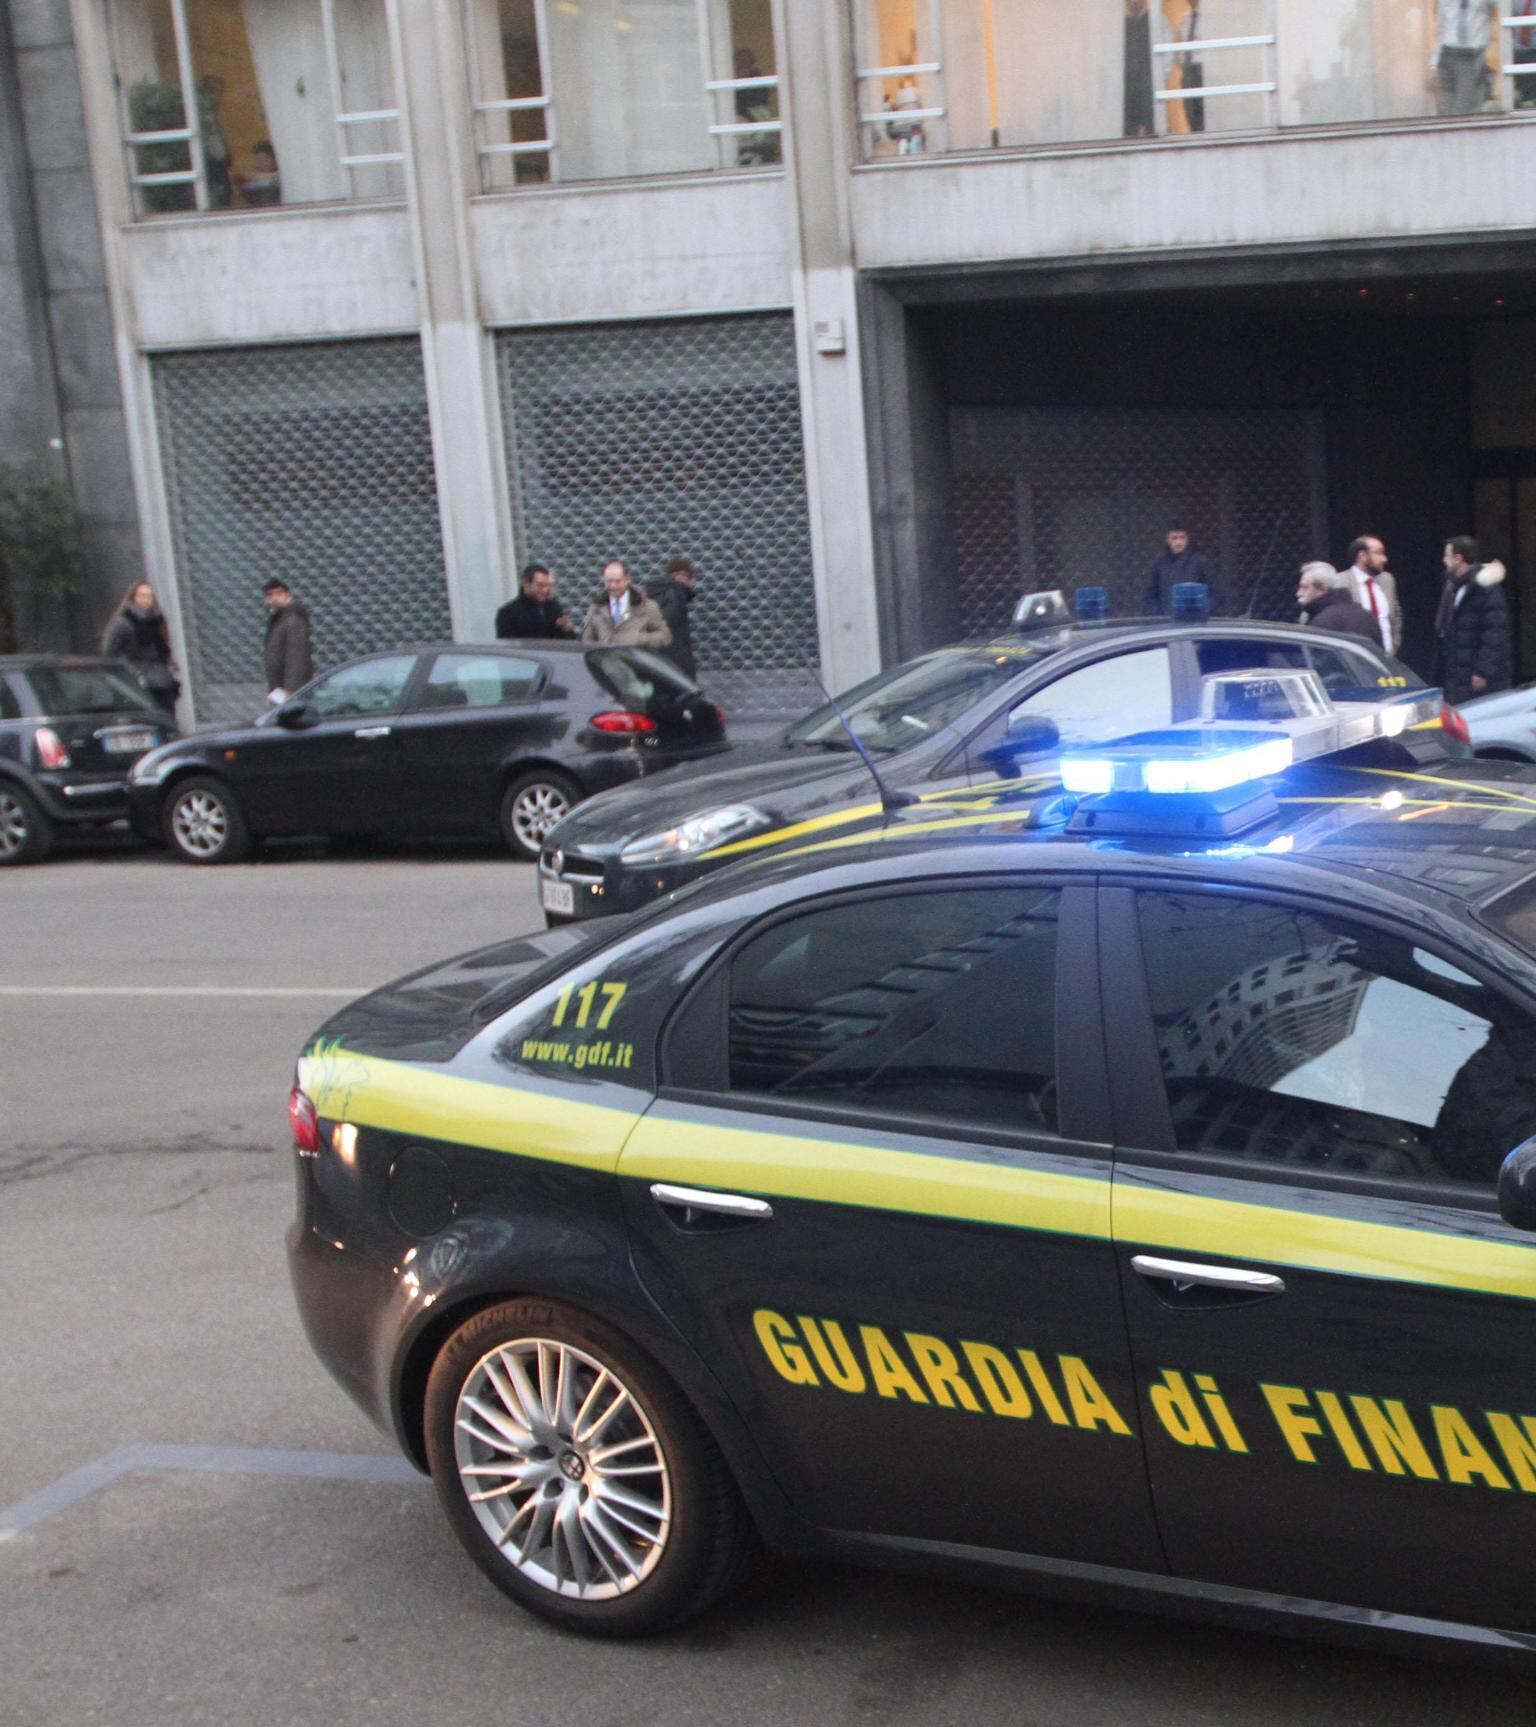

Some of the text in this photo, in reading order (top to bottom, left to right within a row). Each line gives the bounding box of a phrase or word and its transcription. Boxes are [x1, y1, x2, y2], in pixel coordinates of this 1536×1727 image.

[552, 981, 627, 1030] 117
[521, 1040, 633, 1069] www.gdf.it
[753, 1308, 1135, 1437] GUARDIA
[1149, 1367, 1251, 1454] di
